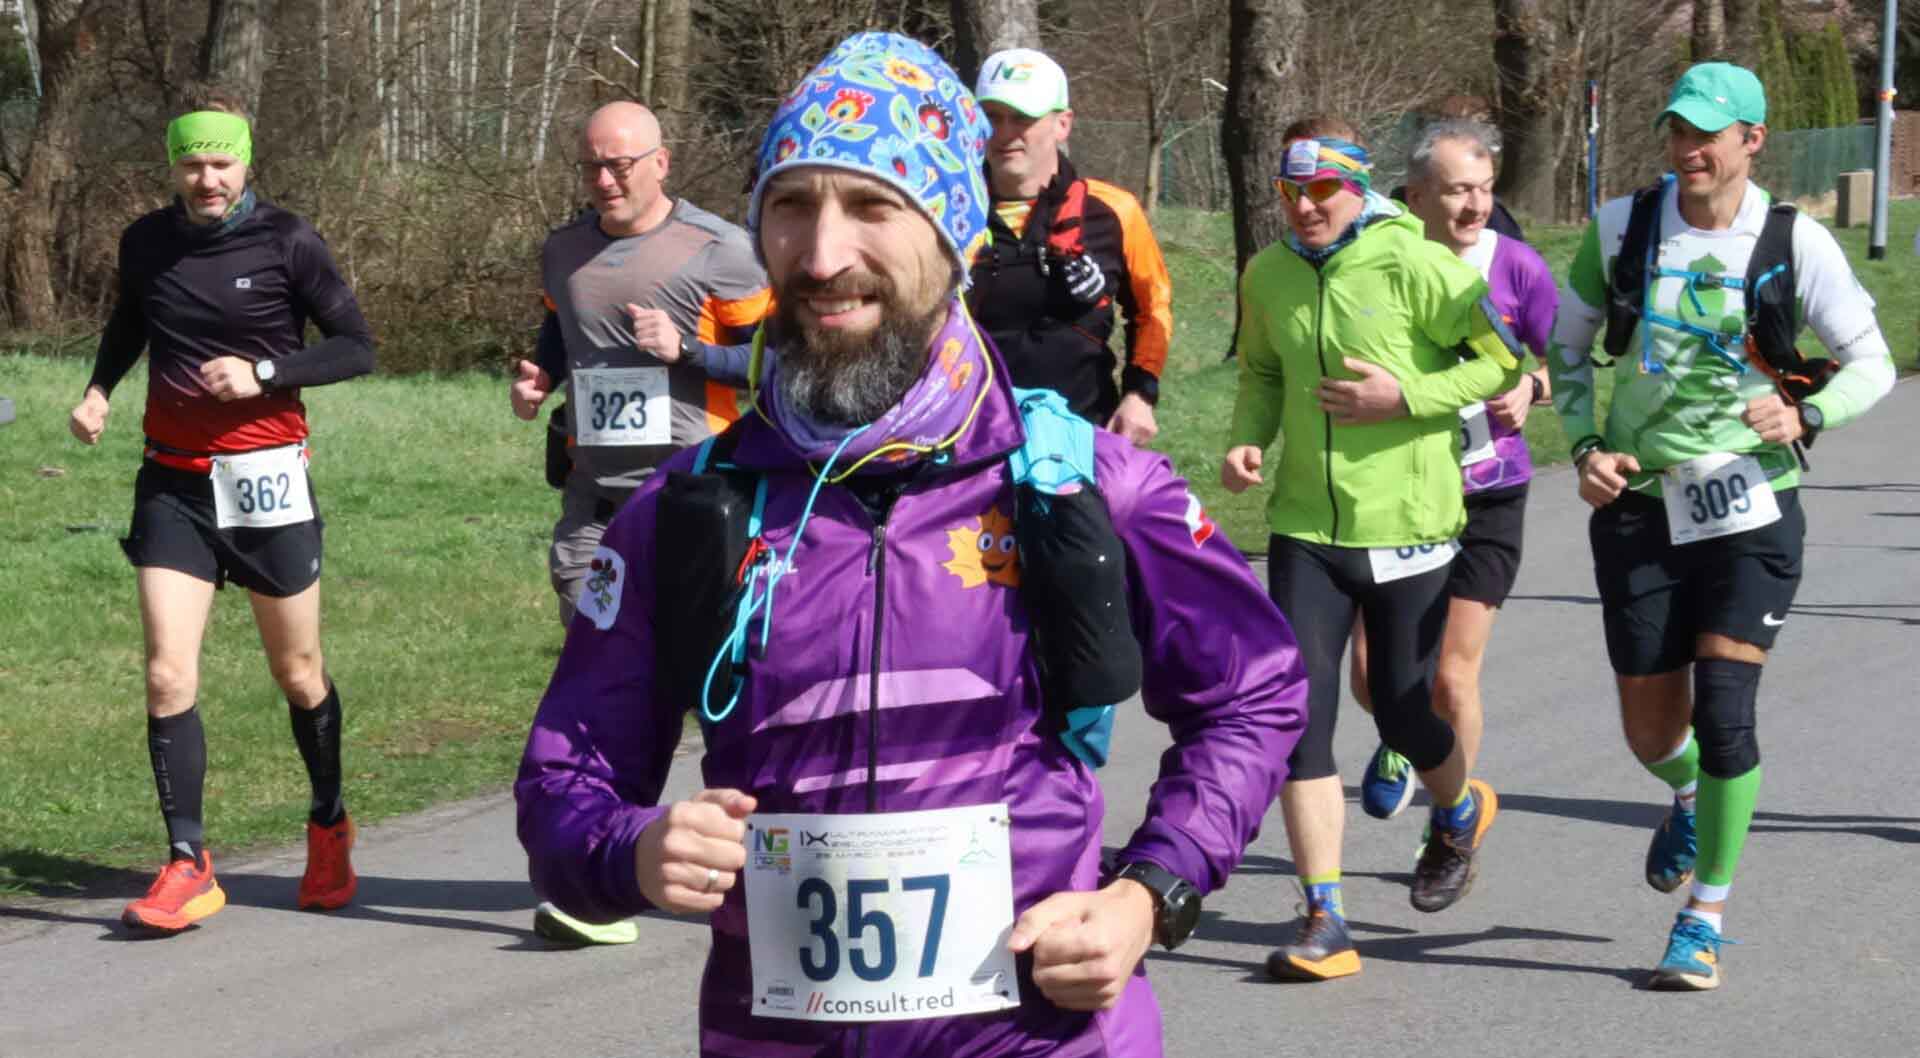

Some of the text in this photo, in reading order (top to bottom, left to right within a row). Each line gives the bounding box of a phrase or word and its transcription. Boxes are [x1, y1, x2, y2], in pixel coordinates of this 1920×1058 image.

[592, 390, 647, 431] 323
[236, 472, 292, 514] 362
[1685, 473, 1752, 525] 309
[796, 873, 950, 982] 357
